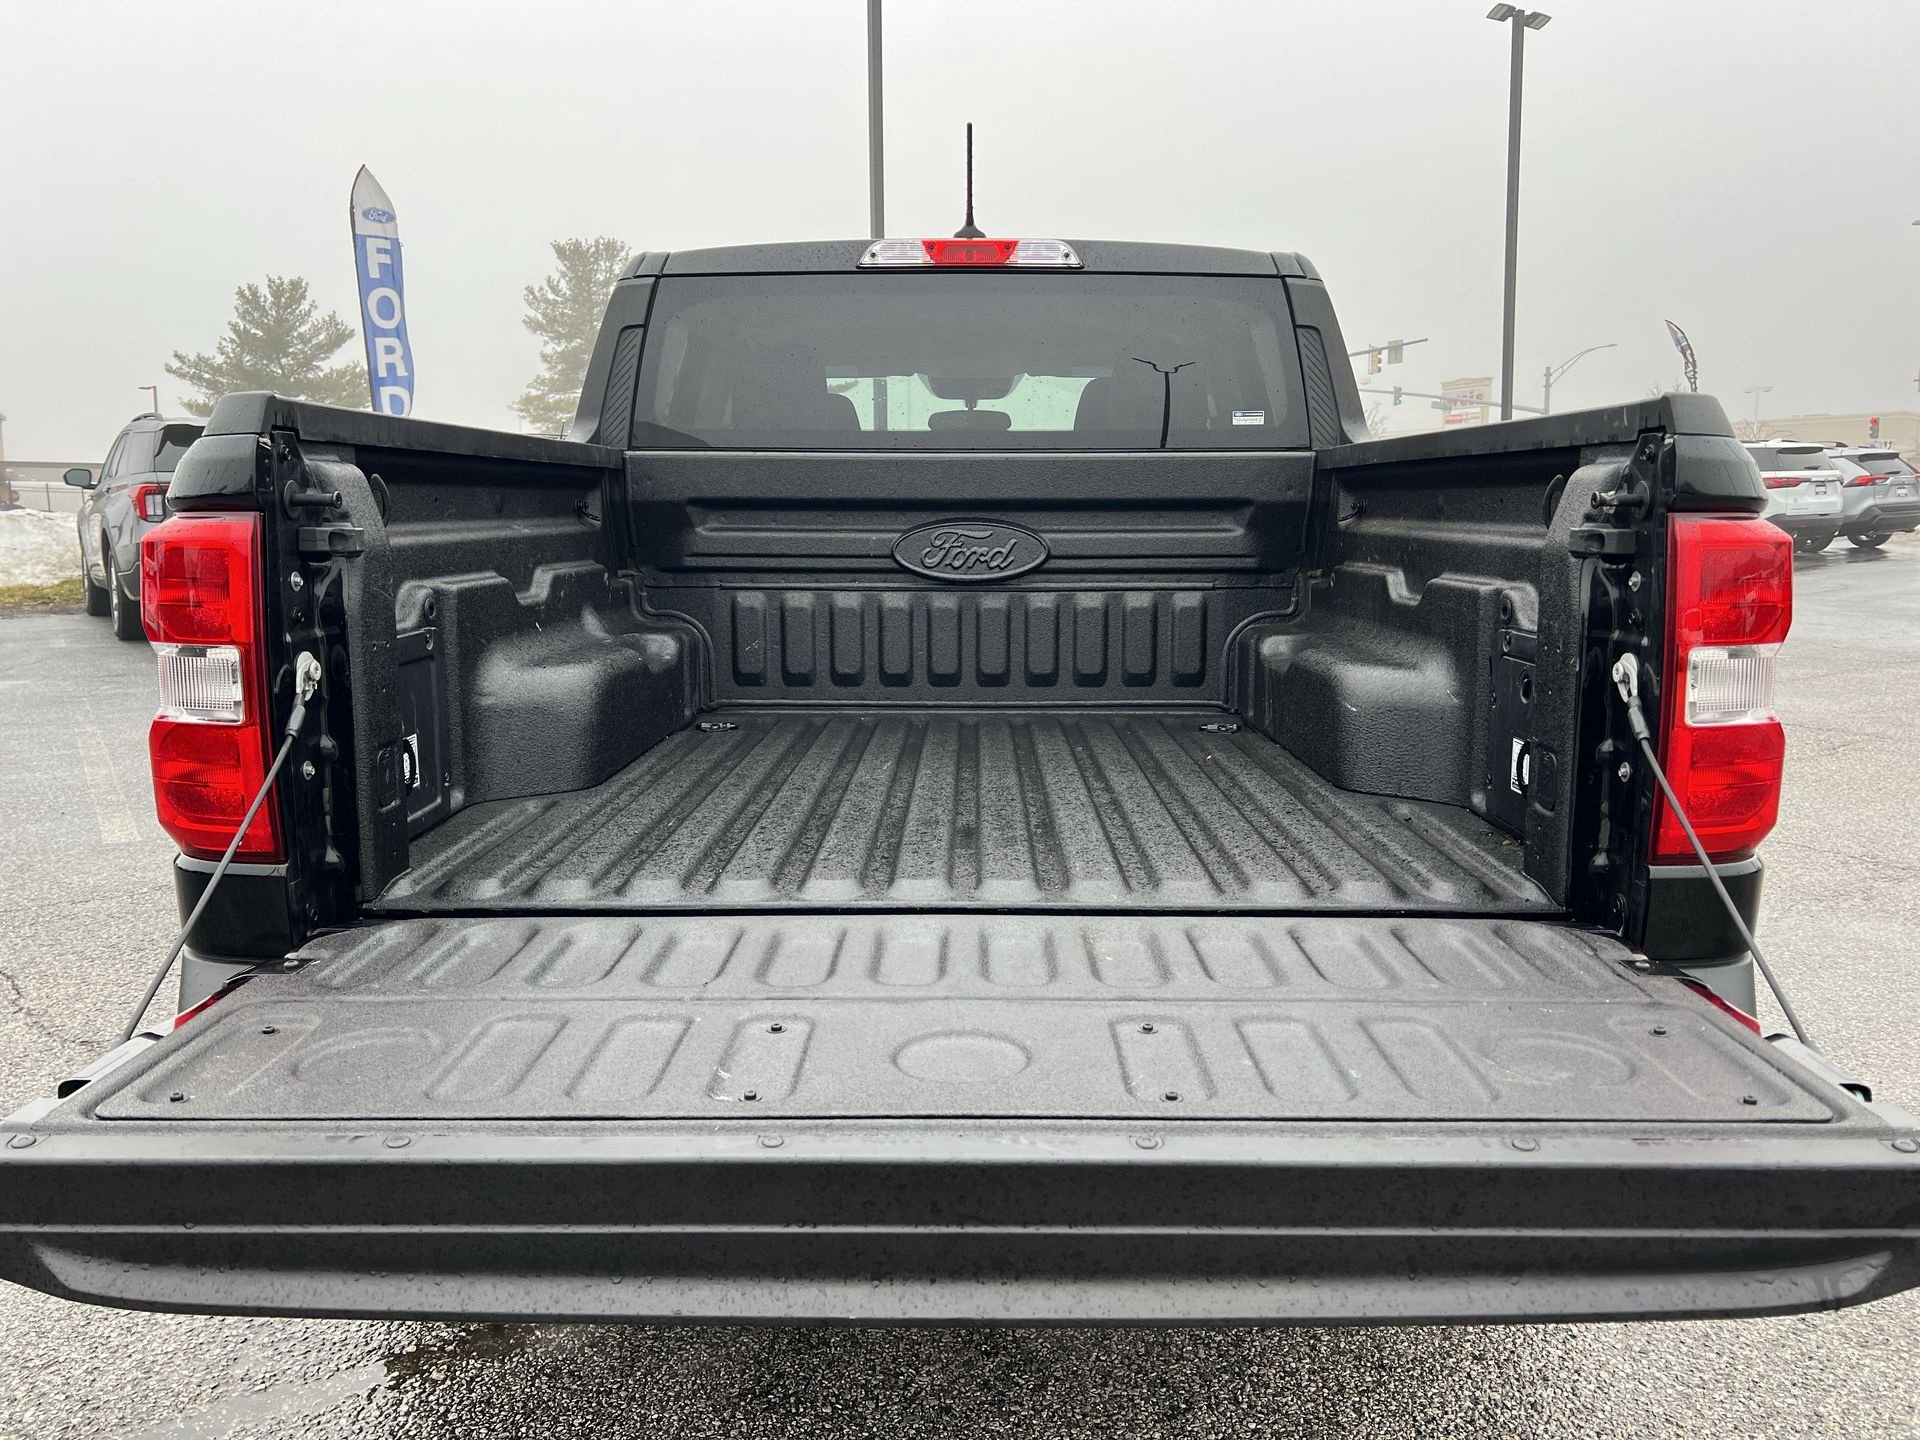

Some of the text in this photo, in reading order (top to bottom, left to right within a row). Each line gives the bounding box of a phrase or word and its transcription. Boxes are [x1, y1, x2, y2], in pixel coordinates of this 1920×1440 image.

[368, 208, 388, 222] Ford
[366, 238, 412, 417] FORD
[920, 528, 1018, 570] Ford
